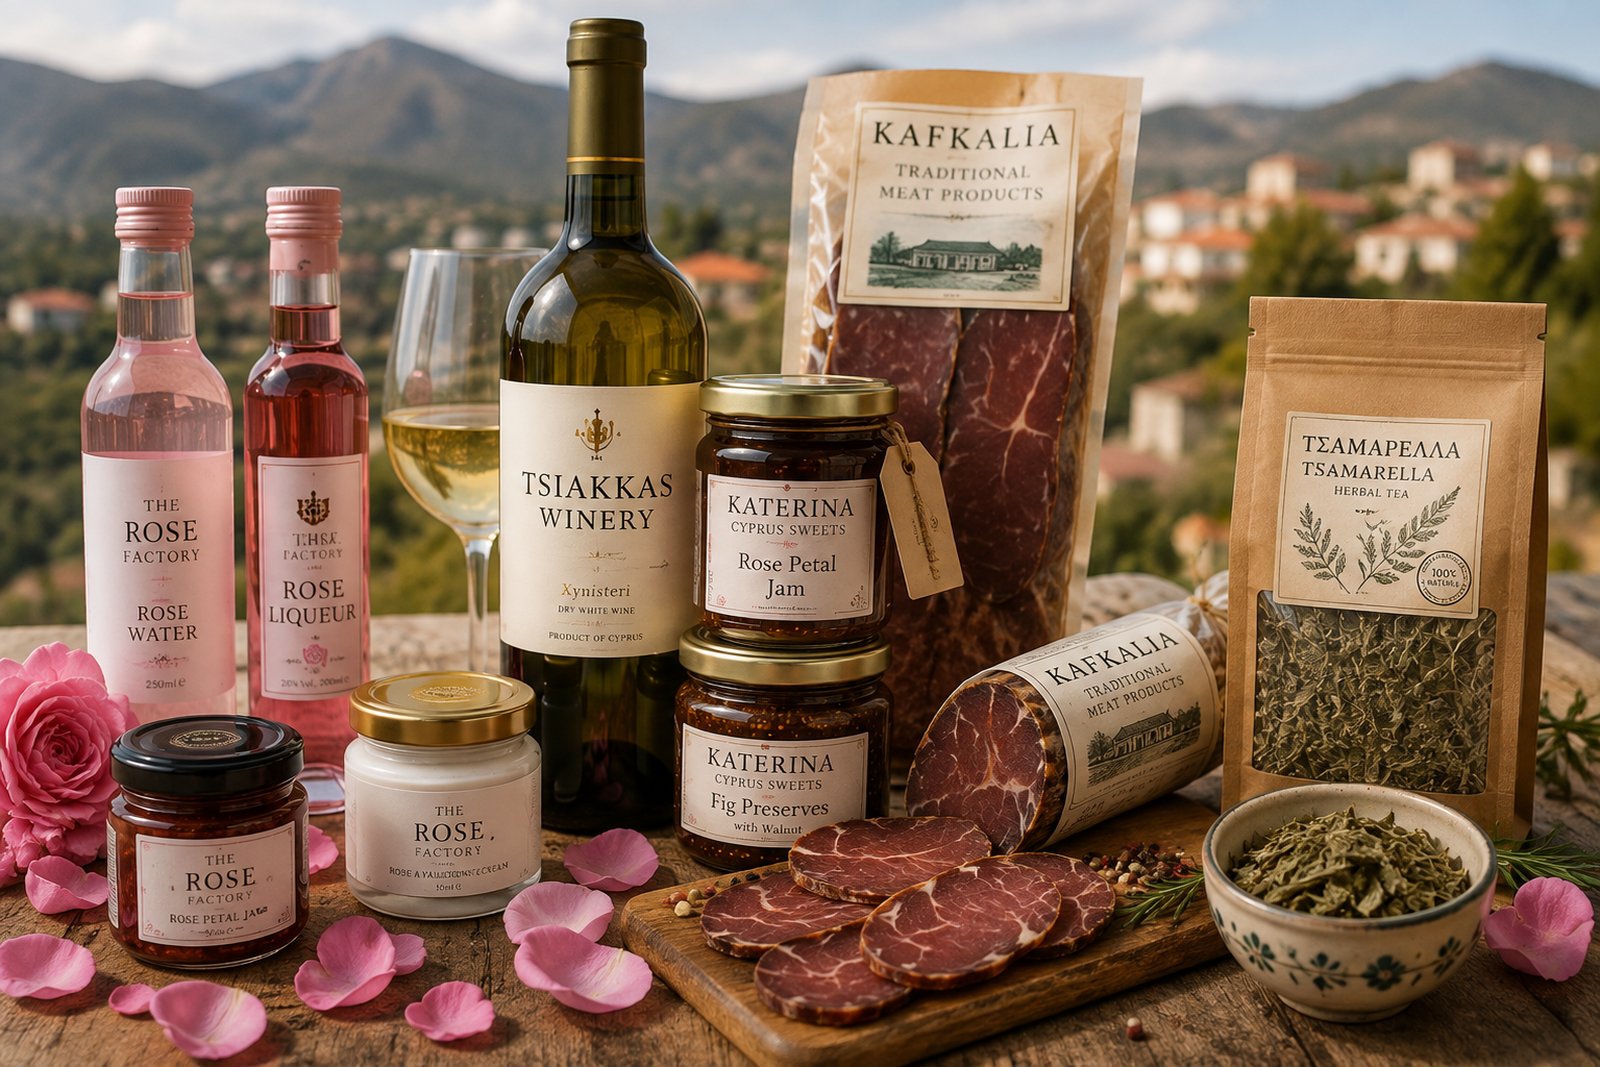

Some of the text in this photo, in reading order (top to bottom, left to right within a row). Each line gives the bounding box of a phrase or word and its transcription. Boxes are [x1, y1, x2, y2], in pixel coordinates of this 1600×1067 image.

[873, 121, 1060, 150] KAFKALIA
[895, 163, 1031, 181] TRADITIONAL
[879, 185, 1044, 202] MEAT PRODUCTS
[1302, 435, 1461, 459] ΤΣΑΜΑΡΕΛΛΑ
[1302, 461, 1435, 482] TSAMARELLA
[521, 471, 673, 499] TSIAKKAS
[1334, 485, 1409, 499] HERBAL TEA
[143, 499, 180, 512] THE
[727, 494, 854, 518] KATERINA
[539, 506, 654, 531] WINERY
[124, 519, 198, 543] ROSE
[731, 521, 846, 536] CYPRUS SWEETS
[123, 548, 200, 563] FACTORY
[738, 552, 837, 573] Rose Petal
[283, 579, 345, 600] ROSE
[561, 583, 631, 600] Xynisteri
[765, 578, 806, 600] Jam
[137, 604, 189, 621] ROSE
[269, 603, 357, 627] LIQUEUR
[558, 604, 635, 615] DRY WHITE WINE
[127, 624, 198, 642] WATER
[548, 631, 643, 643] PRODUCT OF CYPRUS
[1045, 632, 1179, 687] KAFKALIA
[145, 679, 177, 689] 250ml
[1083, 662, 1171, 700] TRADITIONAL
[1086, 675, 1185, 719] MEAT PRODUCTS
[707, 747, 834, 774] KATERINA
[714, 774, 823, 791] CYPRUS SWEETS
[435, 805, 464, 817] THE
[711, 792, 829, 818] Fig Preserves
[734, 822, 758, 833] with
[204, 853, 236, 867] THE
[415, 845, 481, 858] FACTORY
[185, 867, 256, 892] ROSE
[187, 890, 253, 906] FACTORY
[169, 913, 199, 925] ROSE
[203, 913, 240, 925] PETAL
